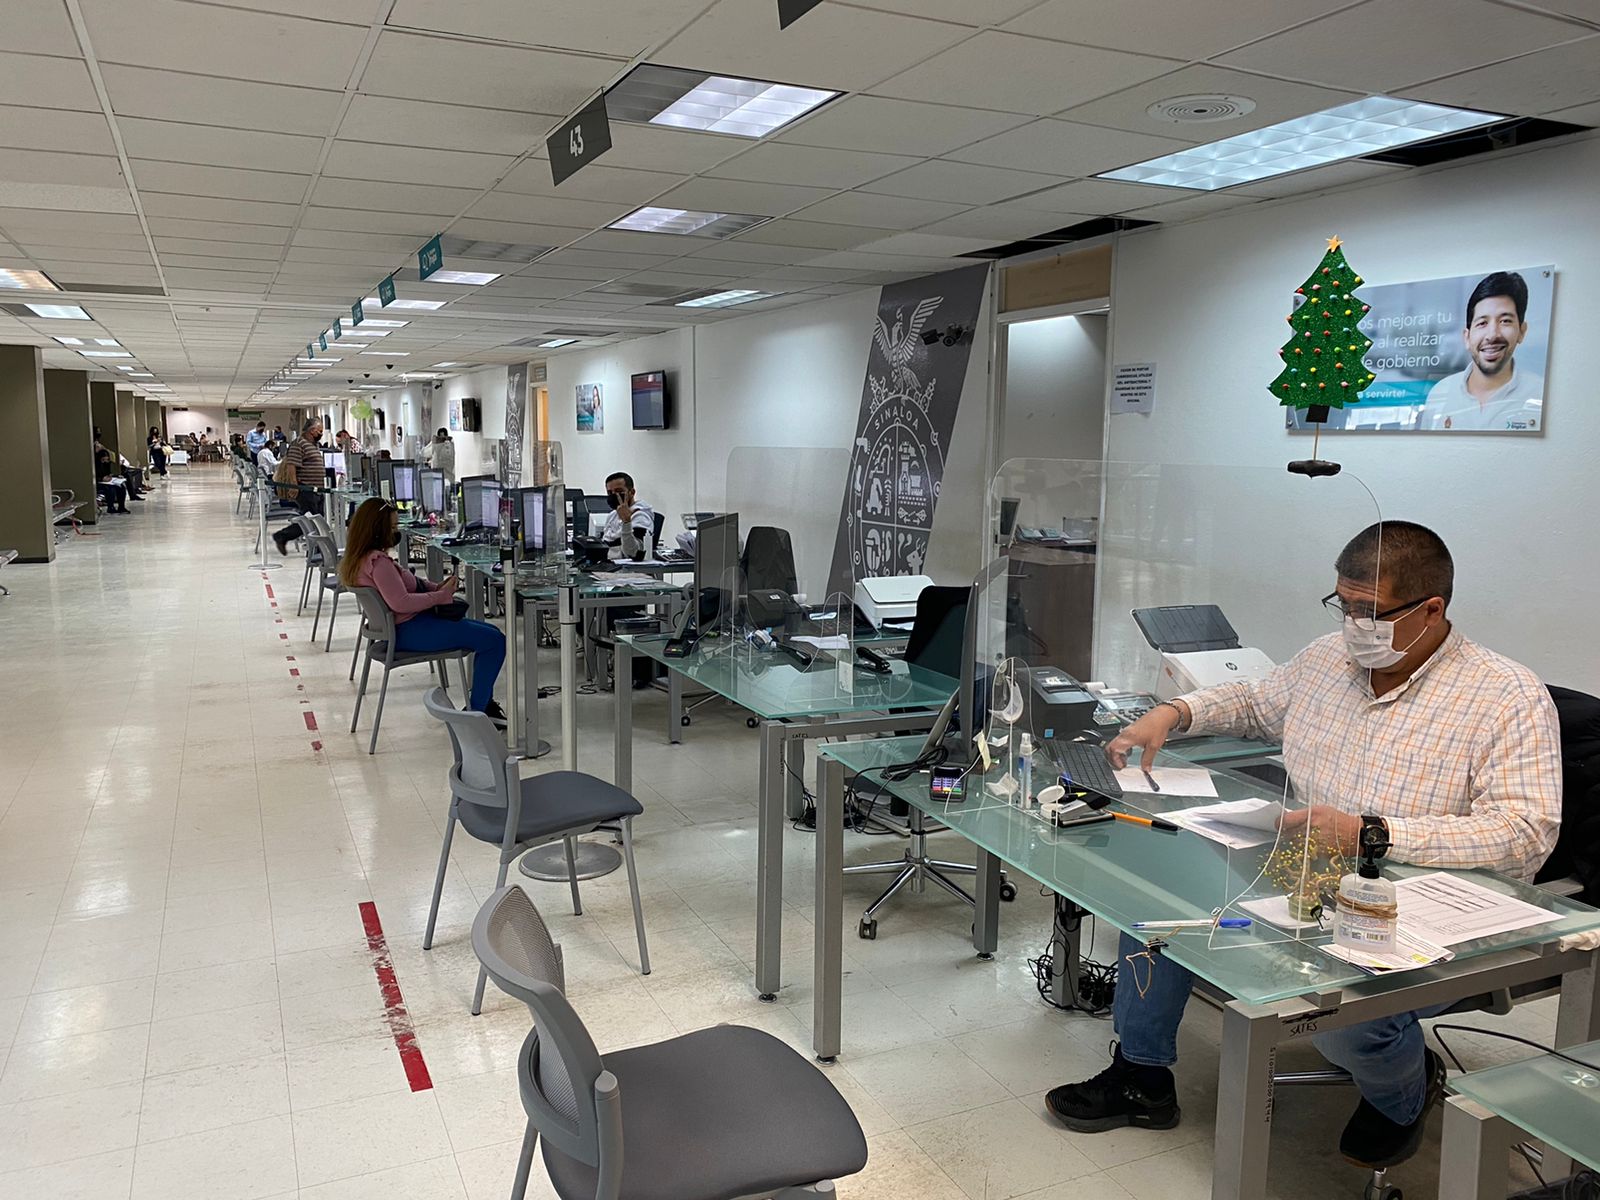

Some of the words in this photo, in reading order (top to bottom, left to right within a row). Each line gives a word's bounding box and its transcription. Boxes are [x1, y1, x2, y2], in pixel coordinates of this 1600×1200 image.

[570, 124, 584, 157] 43
[1377, 312, 1433, 330] mejorar
[1437, 311, 1452, 323] tu
[1378, 335, 1389, 349] al
[1394, 332, 1445, 348] realizar
[1377, 353, 1440, 372] gobierno
[874, 405, 919, 431] SINALOA
